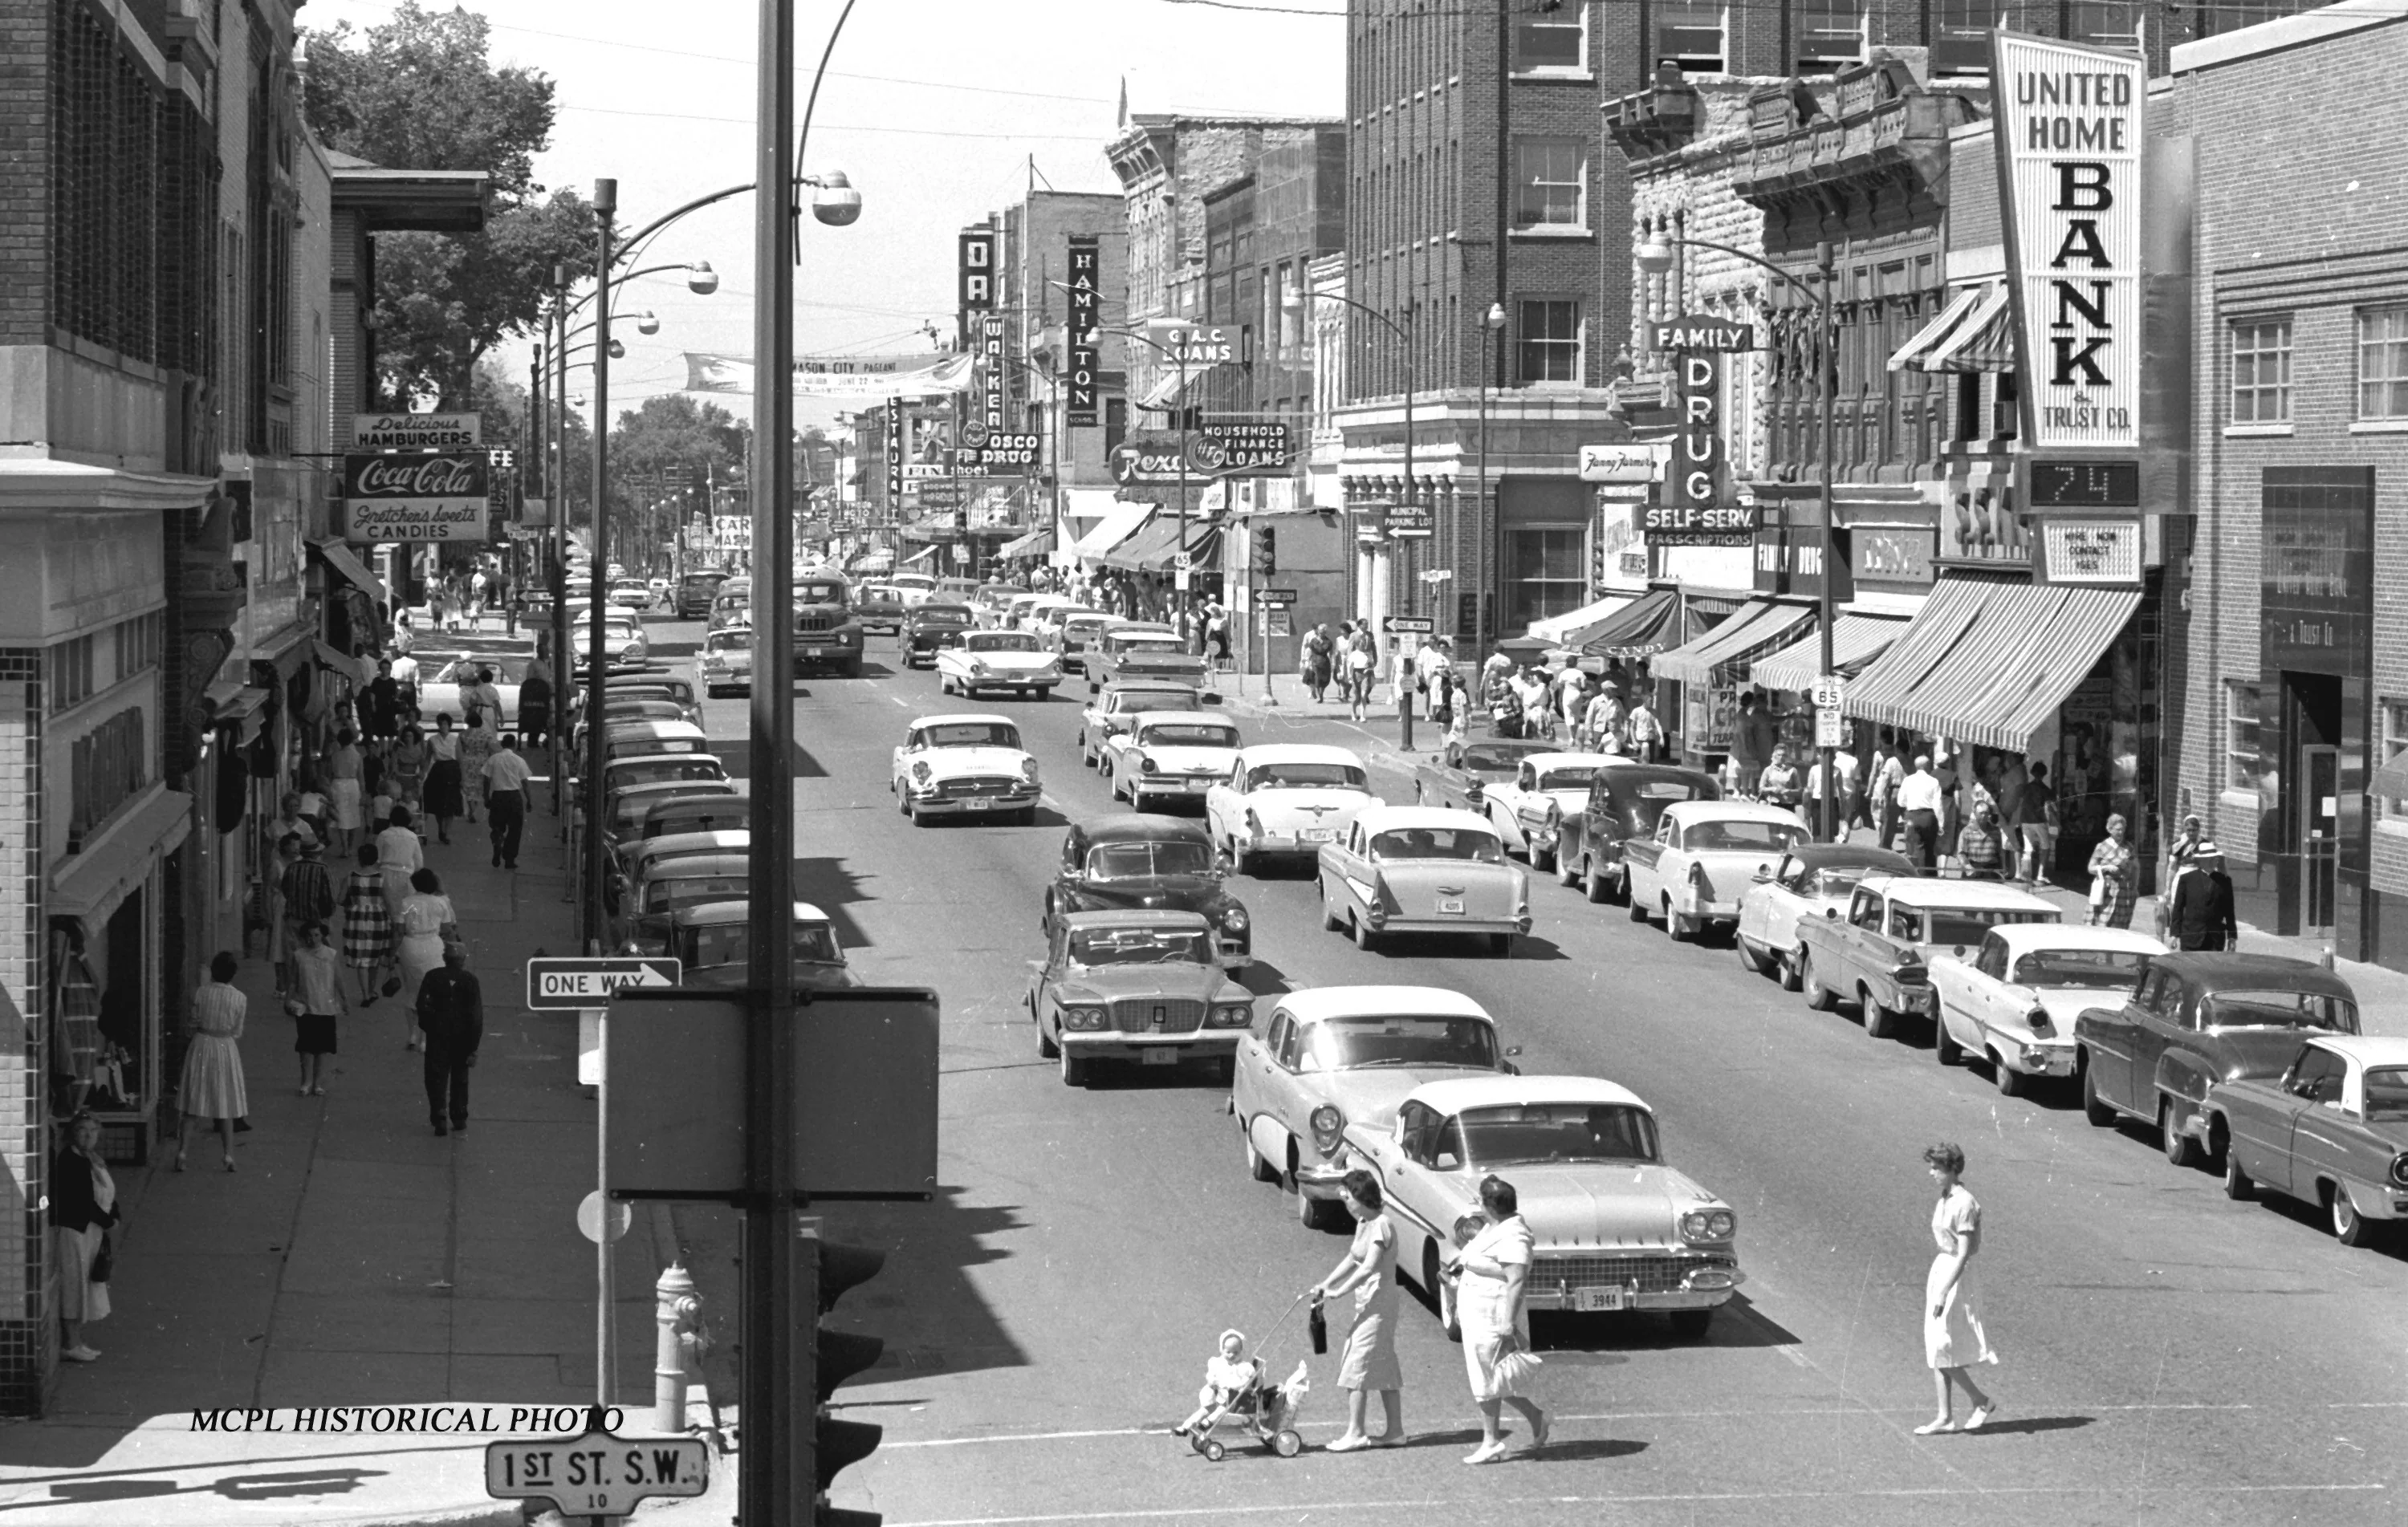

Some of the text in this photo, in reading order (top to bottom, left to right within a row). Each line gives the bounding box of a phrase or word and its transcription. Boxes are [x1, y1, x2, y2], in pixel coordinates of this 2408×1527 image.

[2017, 71, 2131, 107] UNITED
[2028, 116, 2125, 151] HOME
[2051, 161, 2113, 383] BANK
[1074, 254, 1092, 404] HAMILTON
[1658, 327, 1744, 347] FAMILY
[1162, 345, 1231, 361] LOANS
[833, 362, 855, 374] CITY
[986, 322, 1002, 433] WALKER
[2073, 388, 2093, 402] &
[372, 416, 461, 431] Delicious
[2044, 406, 2132, 428] TRUST CO.
[1204, 426, 1285, 437] HOUSEHOLD
[1686, 358, 1713, 500] DRUG
[359, 432, 472, 445] HAMBURGERS
[990, 436, 1038, 449] OSCO
[1225, 439, 1284, 449] FINANCE
[889, 396, 899, 518] ESTAURANT
[981, 450, 1033, 463] DRUG
[1197, 442, 1224, 464] HFC
[1226, 451, 1285, 465] LOANS
[1120, 449, 1191, 481] Rexa
[1584, 452, 1617, 473] Fanny
[357, 457, 475, 494] Coca-Cola
[2054, 466, 2109, 501] 74
[1385, 517, 1433, 526] PARKING LOT
[1645, 509, 1754, 528] SELF-SERV.
[367, 525, 449, 538] CANDIES
[1648, 534, 1751, 546] PRESCRIPTIONS
[2069, 546, 2109, 555] CONTACT
[1413, 621, 1428, 629] WAY
[1819, 691, 1838, 704] 65
[545, 975, 645, 993] ONE WAY
[504, 1449, 688, 1488] 1ST ST. S.W.
[588, 1493, 608, 1509] 10
